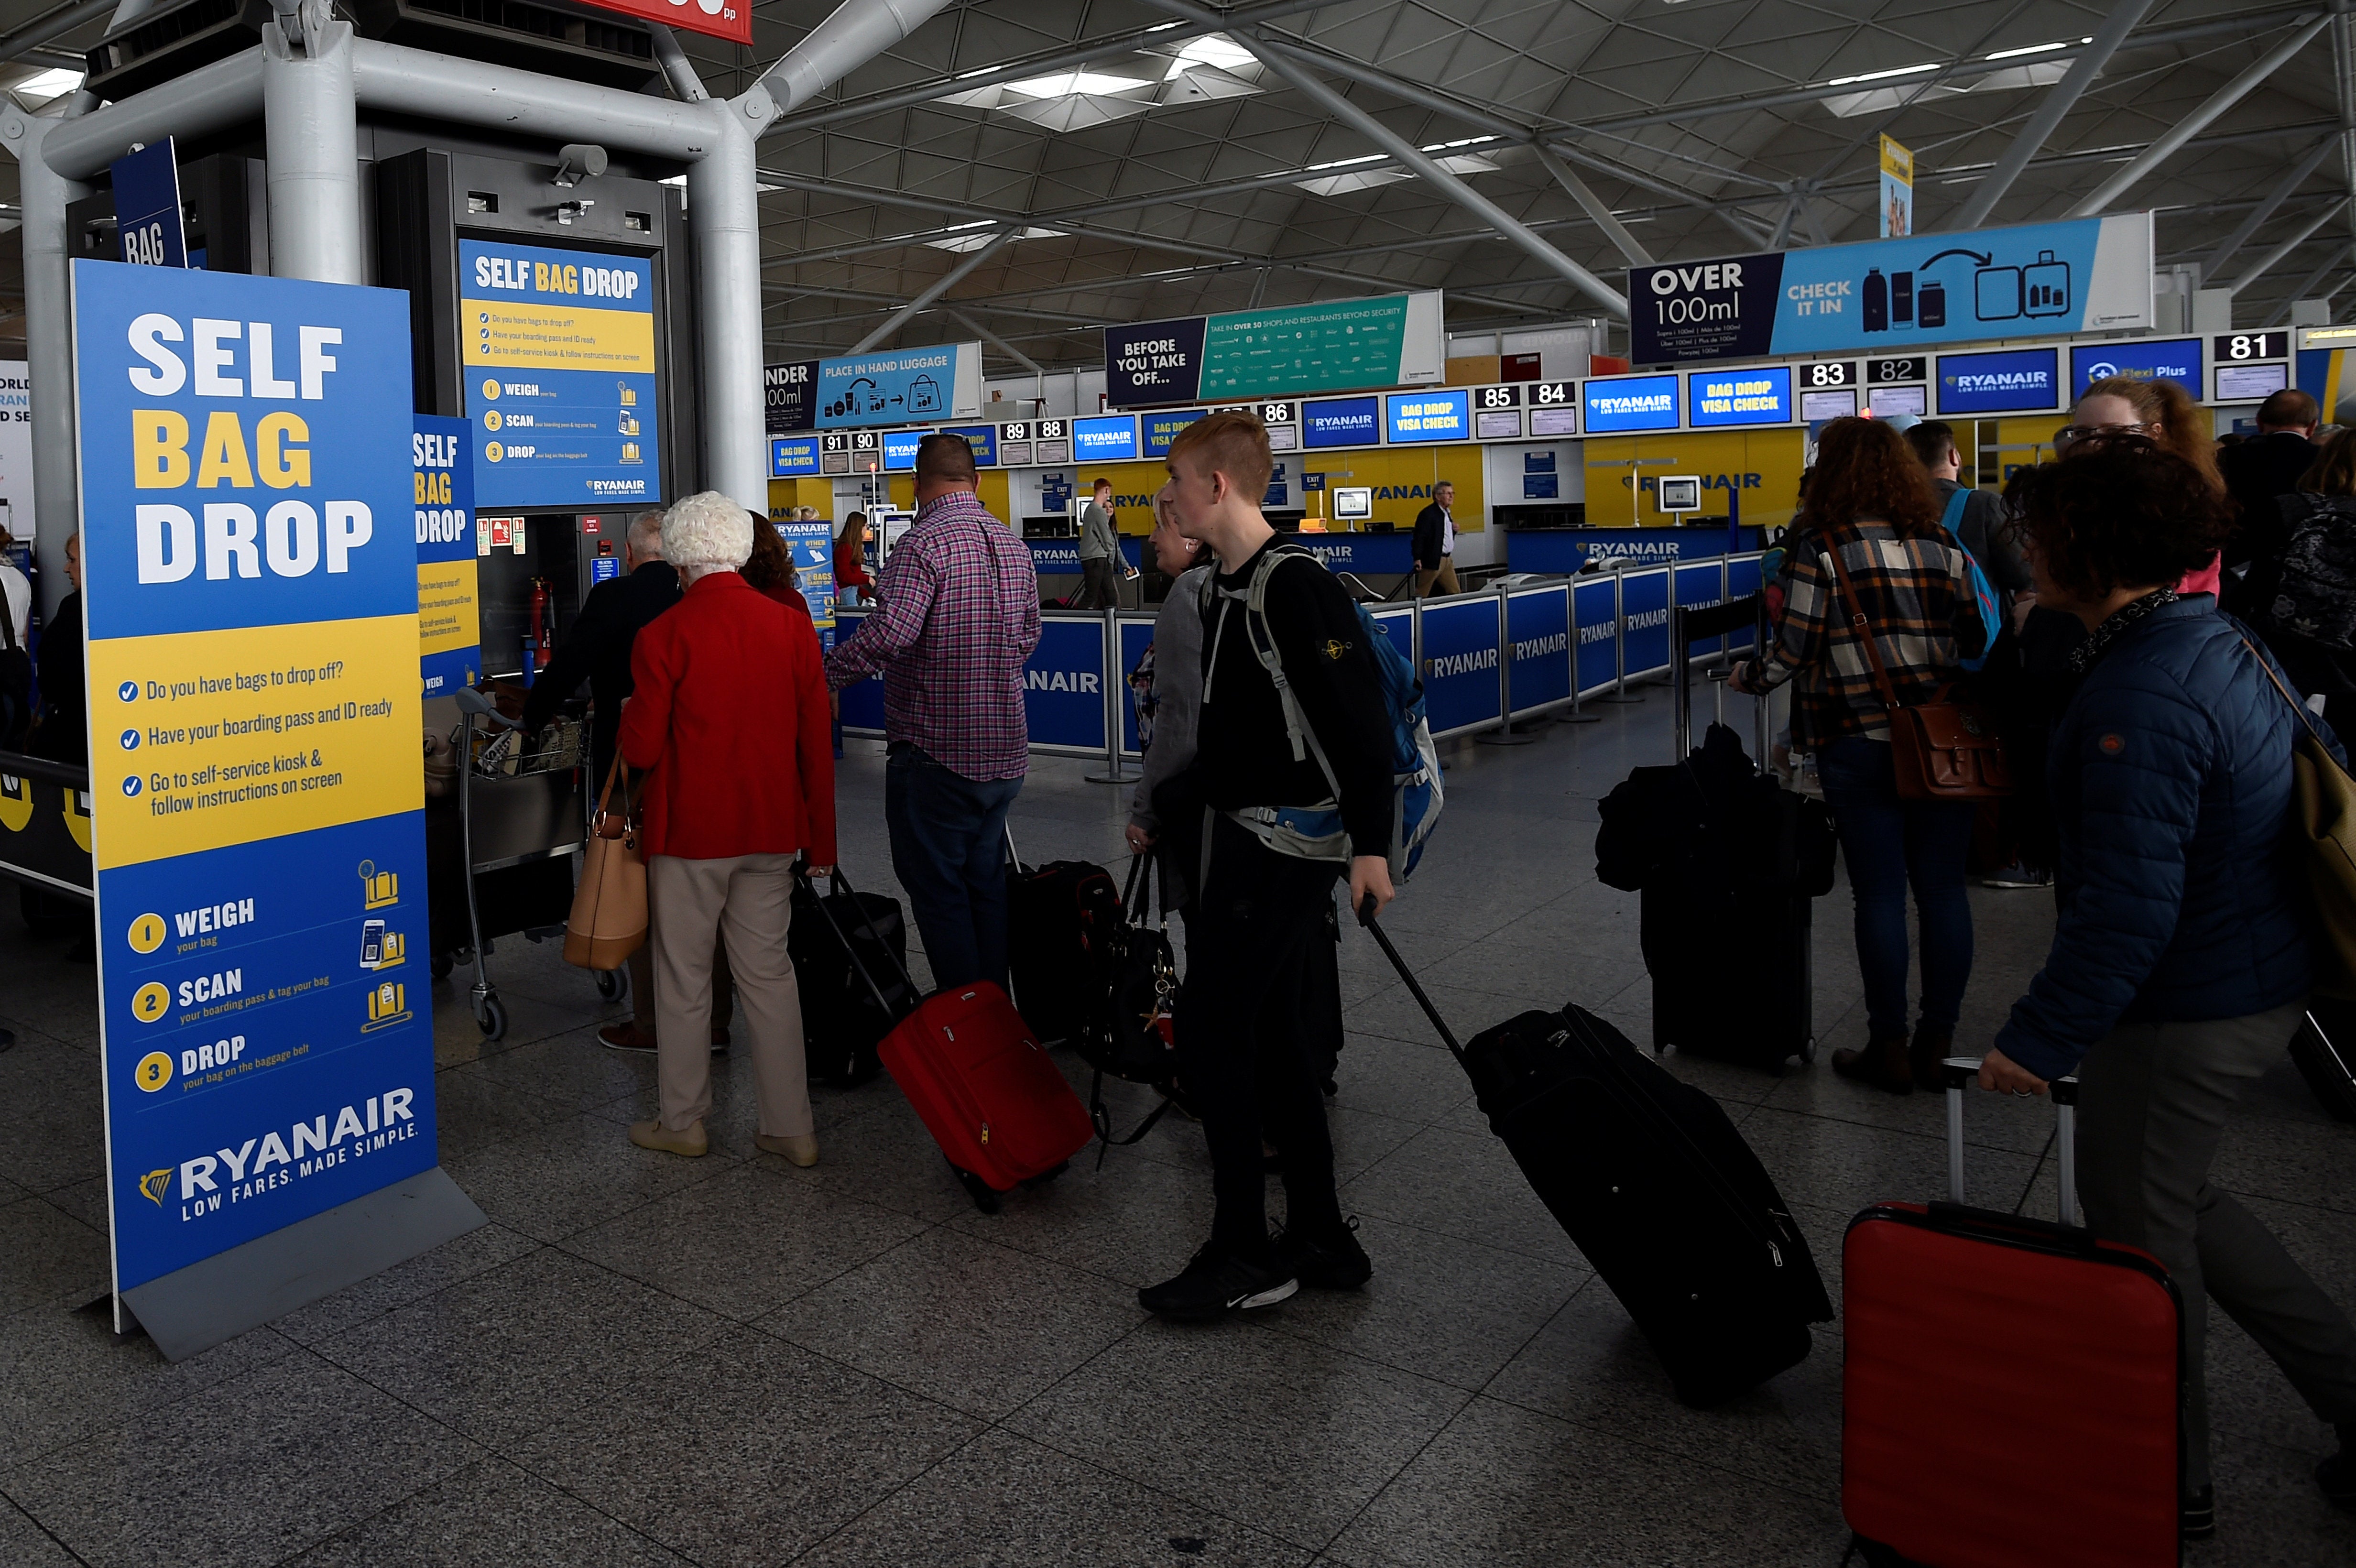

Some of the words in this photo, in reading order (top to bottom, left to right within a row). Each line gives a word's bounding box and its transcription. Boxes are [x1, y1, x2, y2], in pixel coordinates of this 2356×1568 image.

[724, 8, 736, 21] pp
[125, 222, 164, 265] BAG
[475, 256, 530, 290] SELF
[535, 262, 578, 294] BAG
[582, 267, 638, 299] DROP
[1650, 262, 1744, 295] OVER
[1788, 280, 1851, 301] CHECK
[1300, 313, 1342, 323] RESTAURANTS
[1343, 311, 1370, 319] BEYOND
[1371, 307, 1400, 316] SECURITY
[1655, 291, 1739, 325] 100ml
[1798, 301, 1814, 316] IT
[1820, 299, 1842, 315] IN
[528, 317, 541, 326] bags
[549, 319, 562, 327] drop
[523, 333, 547, 342] boarding
[2230, 334, 2266, 359] 81
[1124, 338, 1176, 356] BEFORE
[128, 313, 342, 400] SELF
[1116, 357, 1147, 371] YOU
[1151, 354, 1186, 369] TAKE
[765, 365, 808, 385] NDER
[826, 365, 852, 378] PLACE
[855, 364, 866, 374] IN
[869, 361, 897, 373] HAND
[900, 356, 947, 370] LUGGAGE
[1812, 364, 1844, 386] 83
[1881, 360, 1912, 381] 82
[2157, 366, 2186, 376] Plus
[1132, 371, 1169, 386] OFF...
[1958, 371, 2047, 387] RYANAIR
[504, 383, 539, 396] WEIGH
[768, 385, 801, 406] 00ml
[1485, 389, 1511, 407] 85
[1538, 384, 1565, 403] 84
[1707, 383, 1733, 398] BAG
[1736, 381, 1771, 395] DROP
[1401, 404, 1422, 416] BAG
[1424, 402, 1453, 414] DROP
[1601, 395, 1671, 409] RYANAIR
[1701, 399, 1732, 413] VISA
[1734, 397, 1778, 411] CHECK
[491, 416, 496, 425] 2
[506, 414, 534, 427] SCAN
[1265, 404, 1287, 422] 86
[1316, 414, 1372, 426] RYANAIR
[1006, 424, 1024, 439] 89
[1042, 421, 1060, 437] 88
[1154, 423, 1171, 433] BAG
[1396, 418, 1421, 430] VISA
[1422, 415, 1458, 429] CHECK
[828, 436, 841, 450] 91
[858, 434, 873, 448] 90
[1084, 431, 1131, 442] RYANAIR
[1151, 436, 1170, 446] VISA
[132, 410, 311, 489] BAG
[414, 433, 458, 468] SELF
[492, 447, 497, 457] 3
[507, 446, 535, 458] DROP
[781, 447, 793, 456] BAG
[794, 446, 810, 455] DROP
[778, 458, 793, 467] VISA
[793, 457, 814, 466] CHECK
[414, 471, 452, 505] BAG
[594, 480, 644, 490] RYANAIR
[415, 509, 466, 544] DROP
[778, 525, 829, 534] RYANAIR
[136, 501, 372, 584] DROP
[1589, 542, 1679, 555] RYANAIR
[1034, 550, 1078, 559] RYANA
[1628, 608, 1667, 632] RYANAIR
[1581, 621, 1615, 644] RYANAIR
[1516, 633, 1566, 661] RYANAIR
[1434, 648, 1497, 678] RYANAIR
[147, 681, 166, 700] Do
[170, 682, 195, 701] you
[199, 674, 231, 694] have
[236, 673, 267, 691] bags
[271, 670, 283, 686] to
[287, 667, 315, 686] drop
[319, 661, 343, 680] off?
[426, 675, 444, 690] WEIGH
[1023, 670, 1099, 694] NAIR
[149, 727, 184, 746] Have
[188, 725, 219, 745] your
[223, 715, 281, 736] boarding
[285, 710, 314, 731] pass
[318, 704, 340, 723] and
[344, 702, 356, 719] ID
[360, 699, 392, 717] ready
[151, 773, 169, 792] Go
[174, 771, 187, 788] to
[192, 759, 270, 784] self-service
[274, 752, 306, 773] kiosk
[311, 749, 322, 766] &
[152, 793, 193, 816] follow
[198, 782, 277, 807] instructions
[282, 780, 297, 795] on
[301, 772, 342, 791] screen
[145, 925, 150, 941] 1
[175, 898, 254, 938] WEIGH
[177, 939, 198, 955] your
[200, 936, 217, 949] bag
[145, 994, 156, 1012] 2
[179, 968, 241, 1007] SCAN
[180, 1011, 199, 1025] your
[204, 999, 243, 1020] boarding
[245, 994, 265, 1008] pass
[268, 989, 275, 1000] &
[278, 987, 291, 999] tag
[294, 981, 312, 994] your
[314, 975, 329, 988] bag
[149, 1064, 160, 1080] 3
[182, 1035, 245, 1076] DROP
[183, 1077, 203, 1092] your
[207, 1071, 222, 1084] bag
[225, 1066, 236, 1077] on
[239, 1060, 252, 1074] the
[255, 1049, 291, 1071] baggage
[293, 1043, 309, 1057] belt
[180, 1087, 414, 1200] RYANAIR
[182, 1193, 221, 1222] LOW
[232, 1169, 293, 1203] FARES.
[300, 1148, 346, 1178] MADE
[355, 1122, 418, 1157] SIMPLE.
